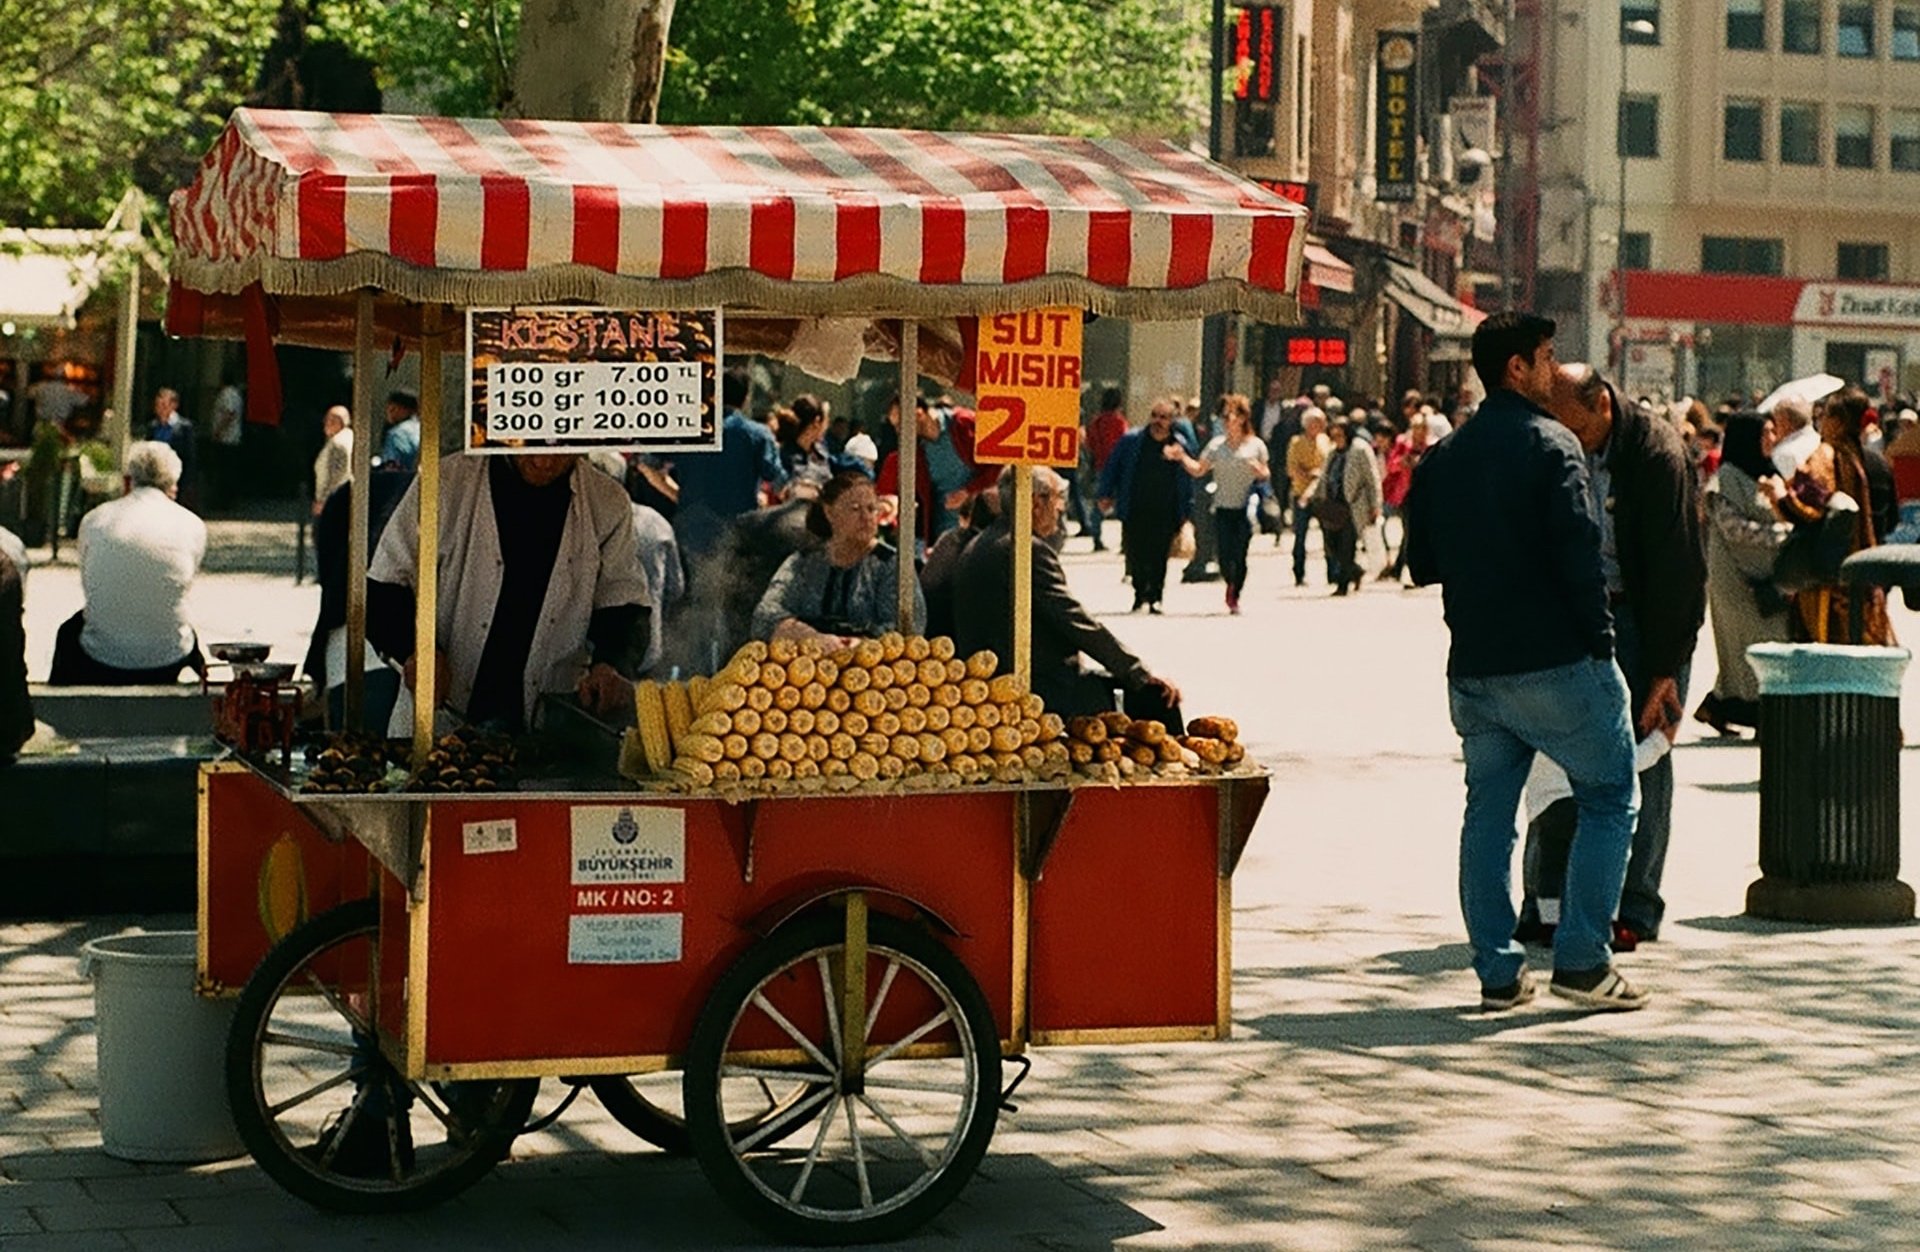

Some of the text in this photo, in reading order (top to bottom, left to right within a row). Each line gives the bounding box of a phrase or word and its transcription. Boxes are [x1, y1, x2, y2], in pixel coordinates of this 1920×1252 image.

[1387, 74, 1407, 181] HOTEL
[501, 317, 682, 350] KESTANE
[494, 366, 696, 388] 100 gr 7.00 TL
[978, 351, 1080, 389] MISIR
[494, 389, 695, 411] 150 gr 10.00 TL
[493, 412, 695, 435] 300 gr 20.00 TL
[578, 854, 673, 873] BÜYÜKŞEHİR
[577, 889, 673, 907] MK / NO: 2
